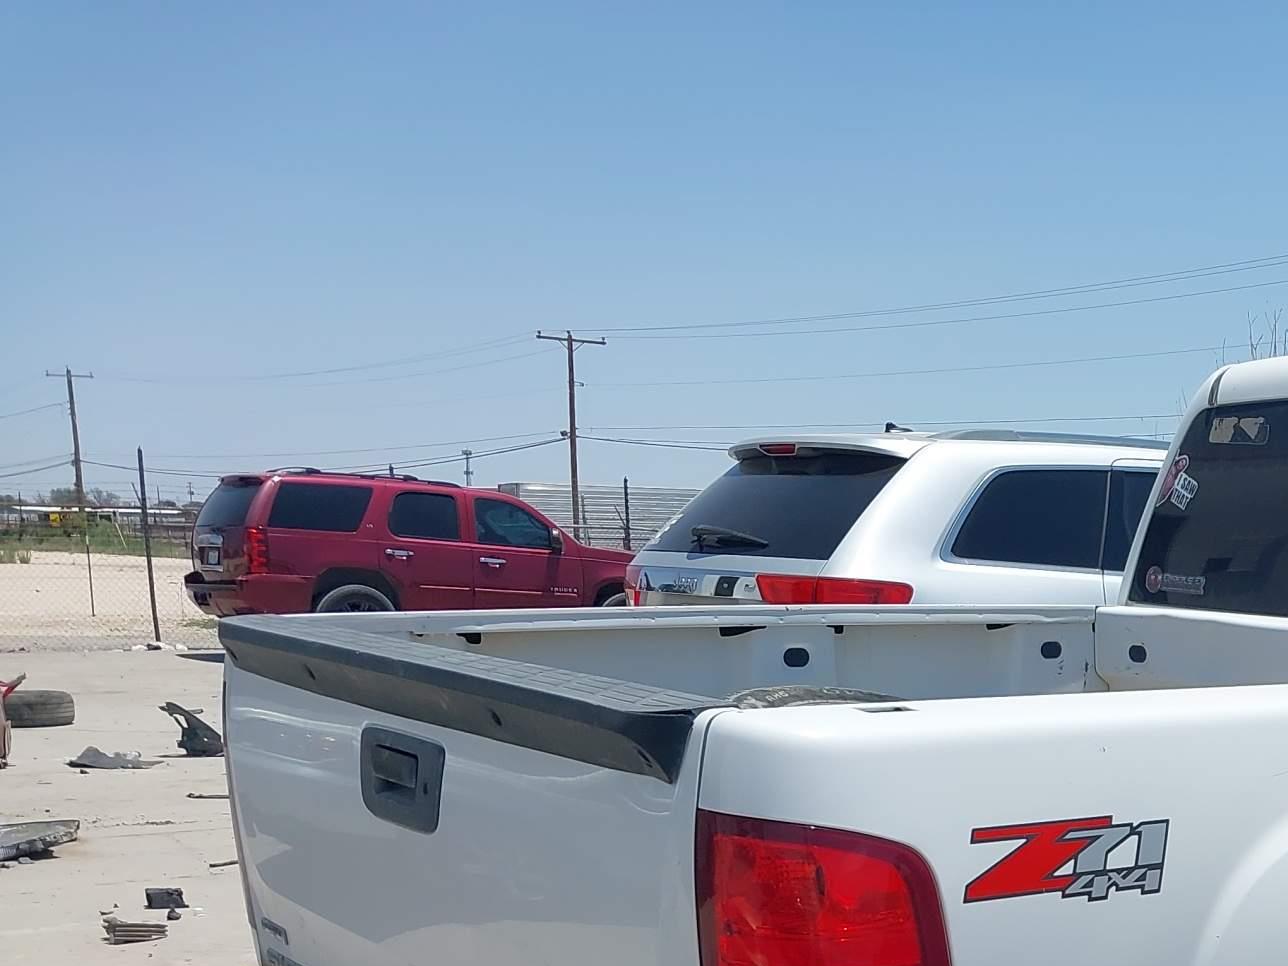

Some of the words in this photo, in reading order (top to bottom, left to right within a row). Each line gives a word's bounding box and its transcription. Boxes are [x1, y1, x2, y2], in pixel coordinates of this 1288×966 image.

[1181, 477, 1197, 496] SAW
[1172, 488, 1188, 508] THAT
[963, 815, 1169, 903] Z71
